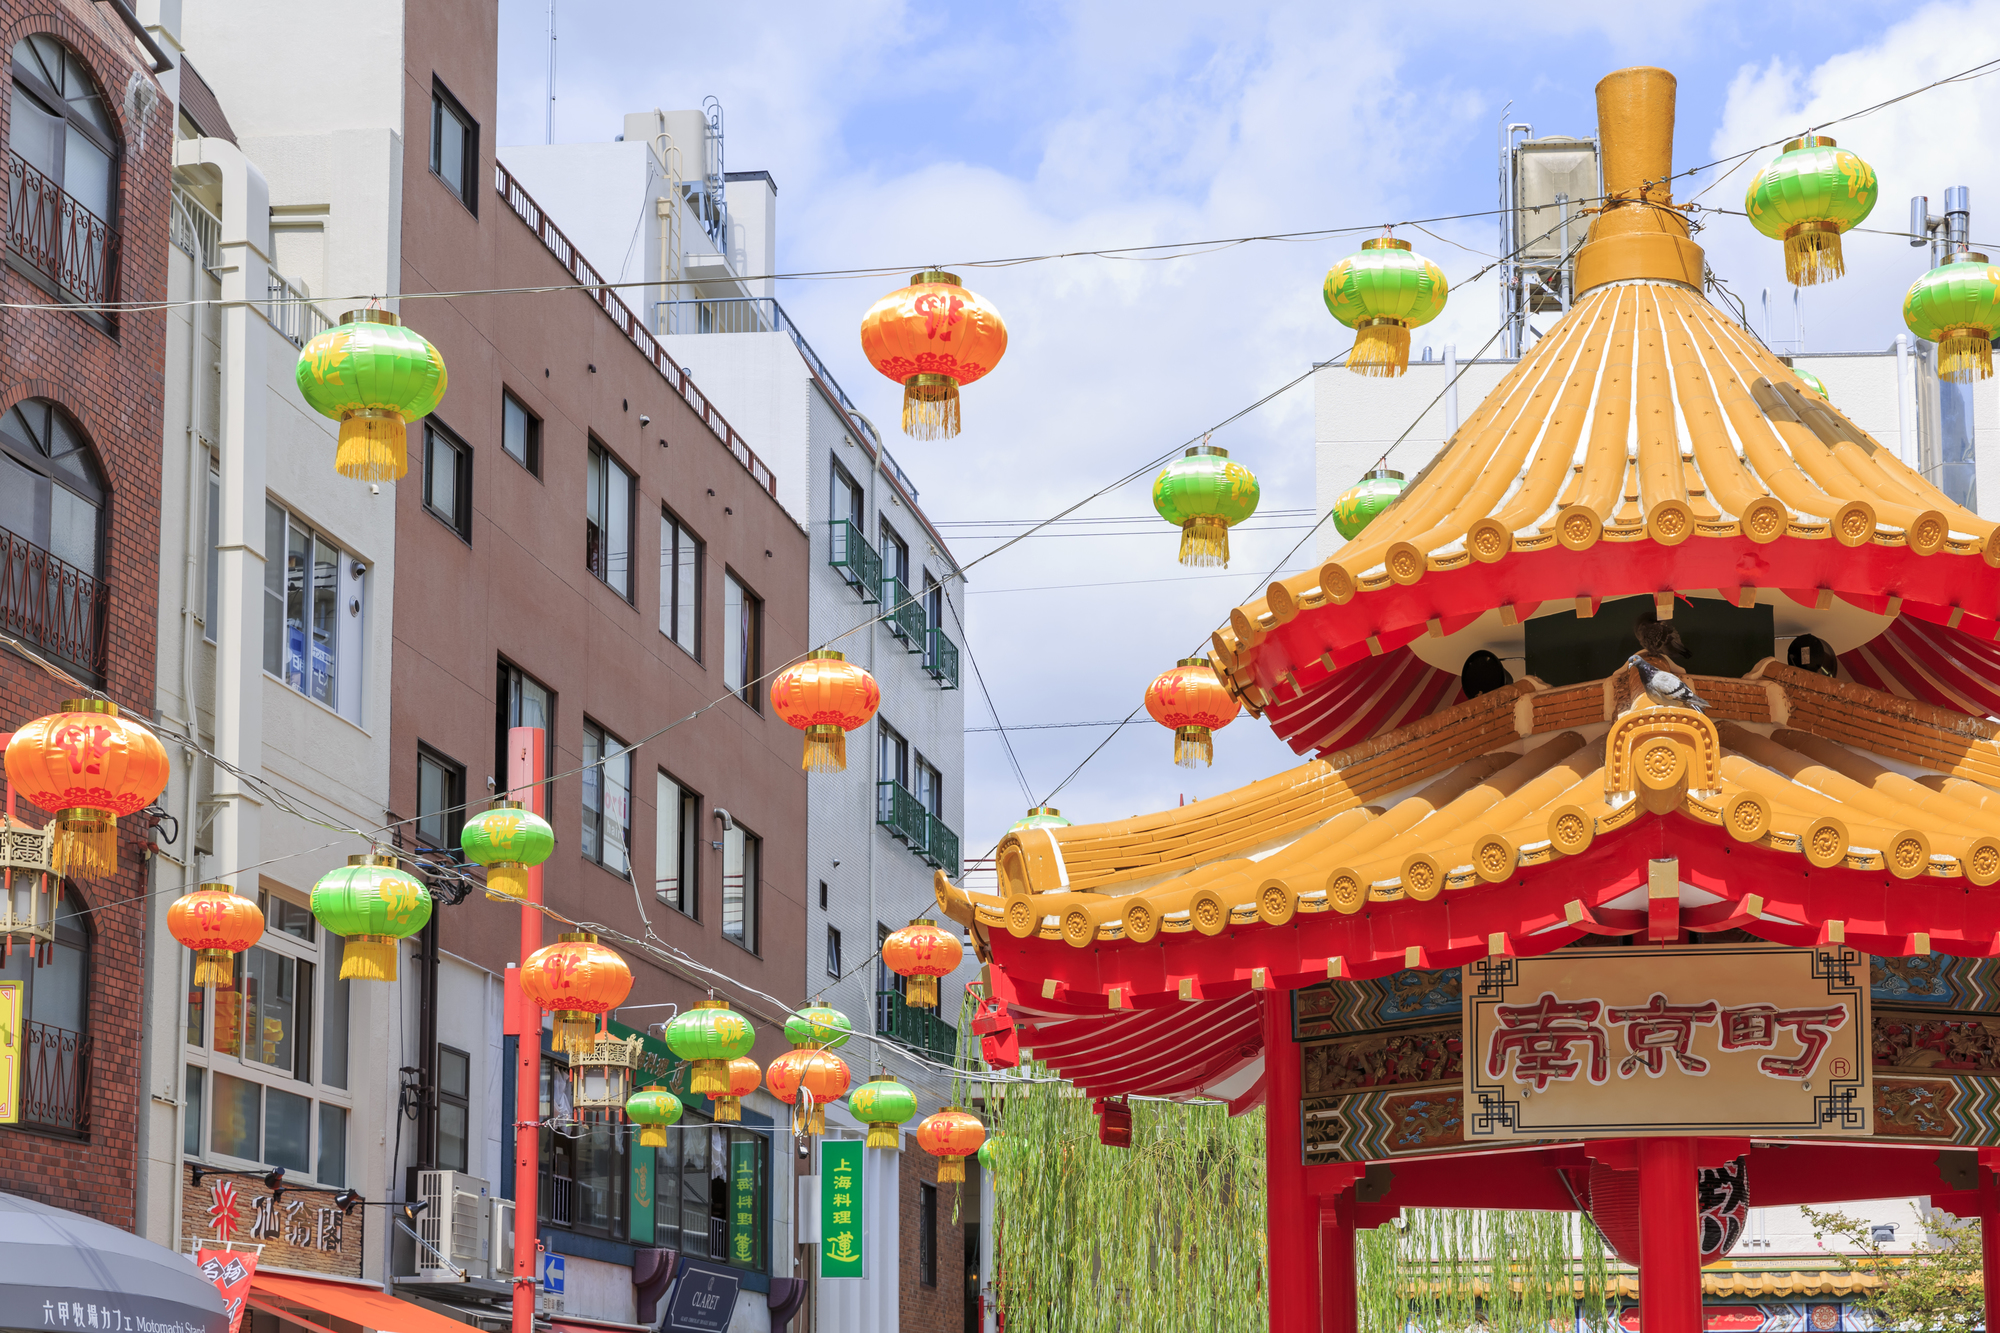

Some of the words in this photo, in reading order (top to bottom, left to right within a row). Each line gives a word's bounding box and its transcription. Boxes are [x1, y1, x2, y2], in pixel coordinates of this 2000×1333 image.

[1486, 991, 1849, 1093] 南京町
[43, 1300, 133, 1332] 六甲牧場カフェ
[136, 1316, 184, 1333] Motomachi
[692, 1291, 720, 1310] CLARET
